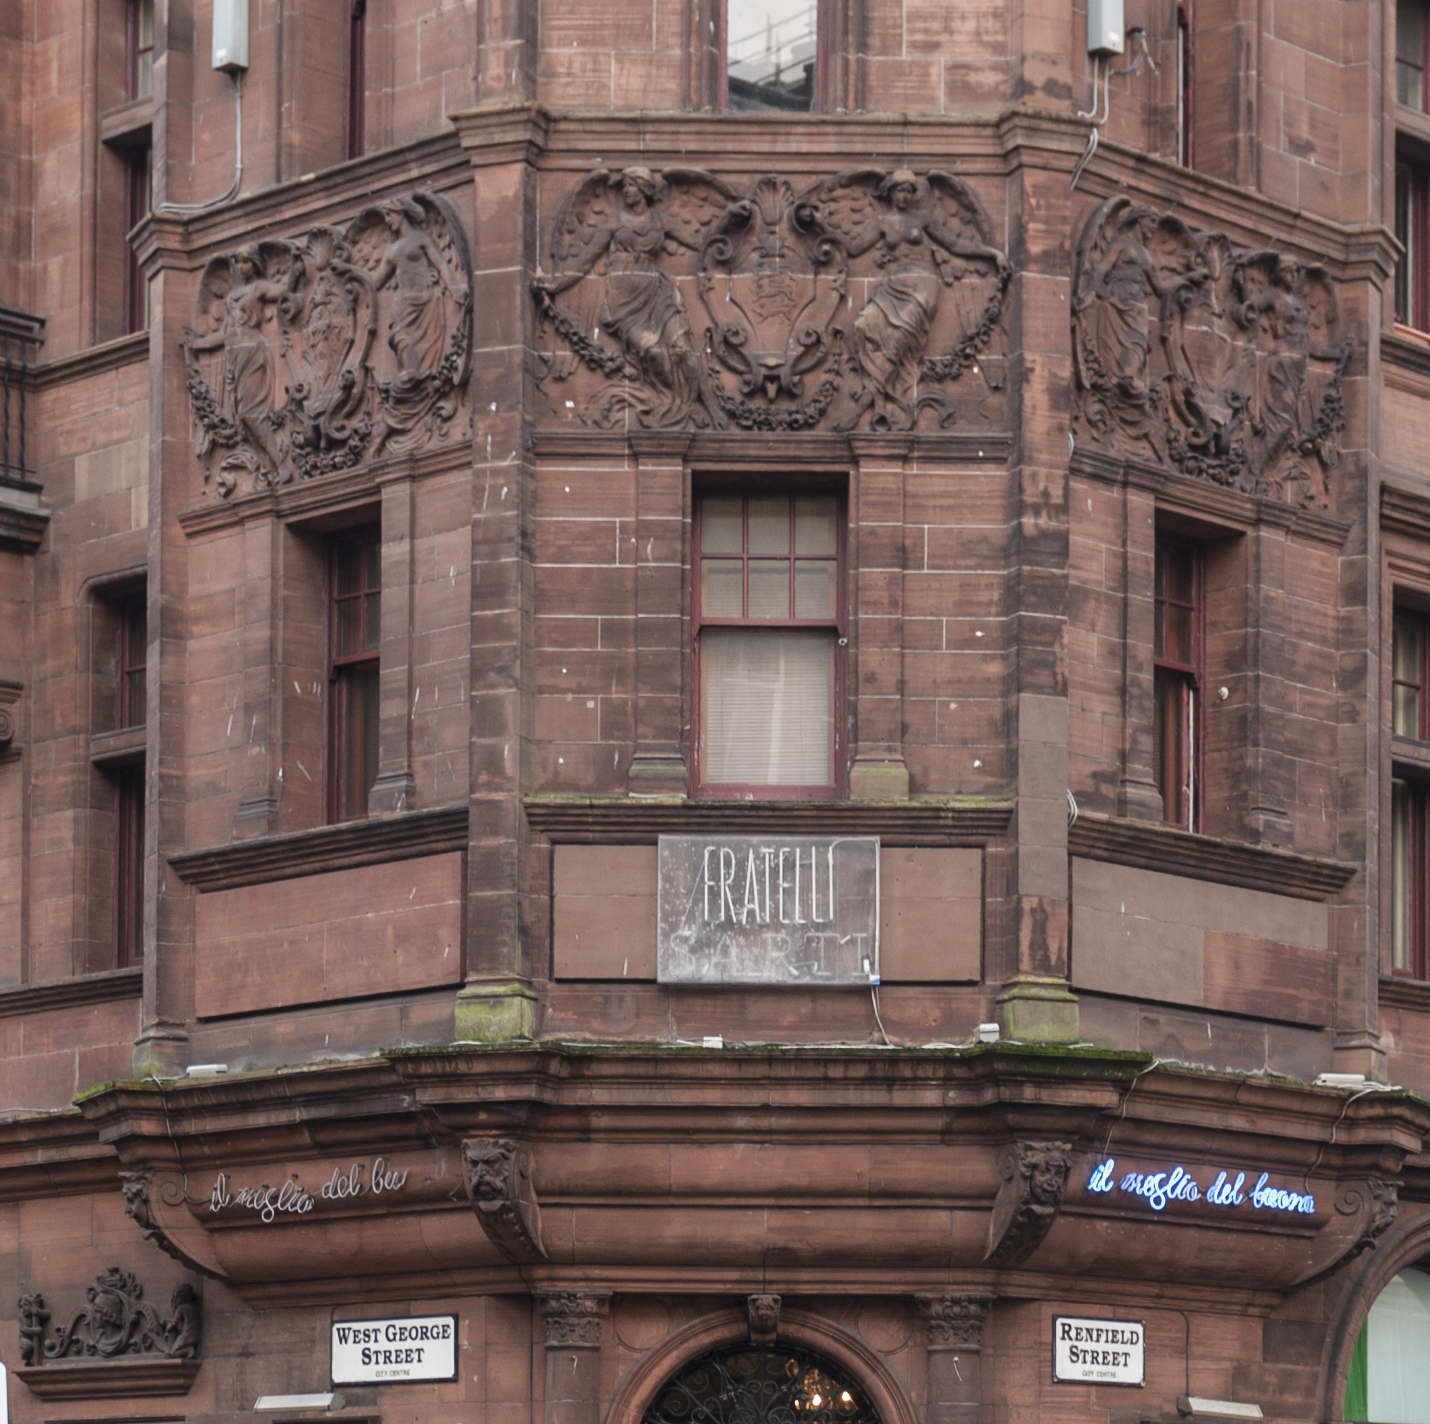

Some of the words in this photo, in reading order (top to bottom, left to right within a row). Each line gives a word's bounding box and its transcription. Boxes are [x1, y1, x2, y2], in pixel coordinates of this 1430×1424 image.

[704, 846, 834, 926] FRATELLI
[670, 931, 869, 977] SARTI
[1087, 1157, 1115, 1193] il
[1206, 1171, 1246, 1205] del
[336, 1327, 381, 1346] WEST
[385, 1323, 451, 1343] GEORGE
[1060, 1322, 1140, 1346] RENFIELD
[361, 1347, 425, 1366] STREET
[1069, 1345, 1131, 1367] STREET
[375, 1370, 388, 1378] CITY
[389, 1369, 410, 1377] CENTRE
[1096, 1370, 1117, 1378] CENTRE
